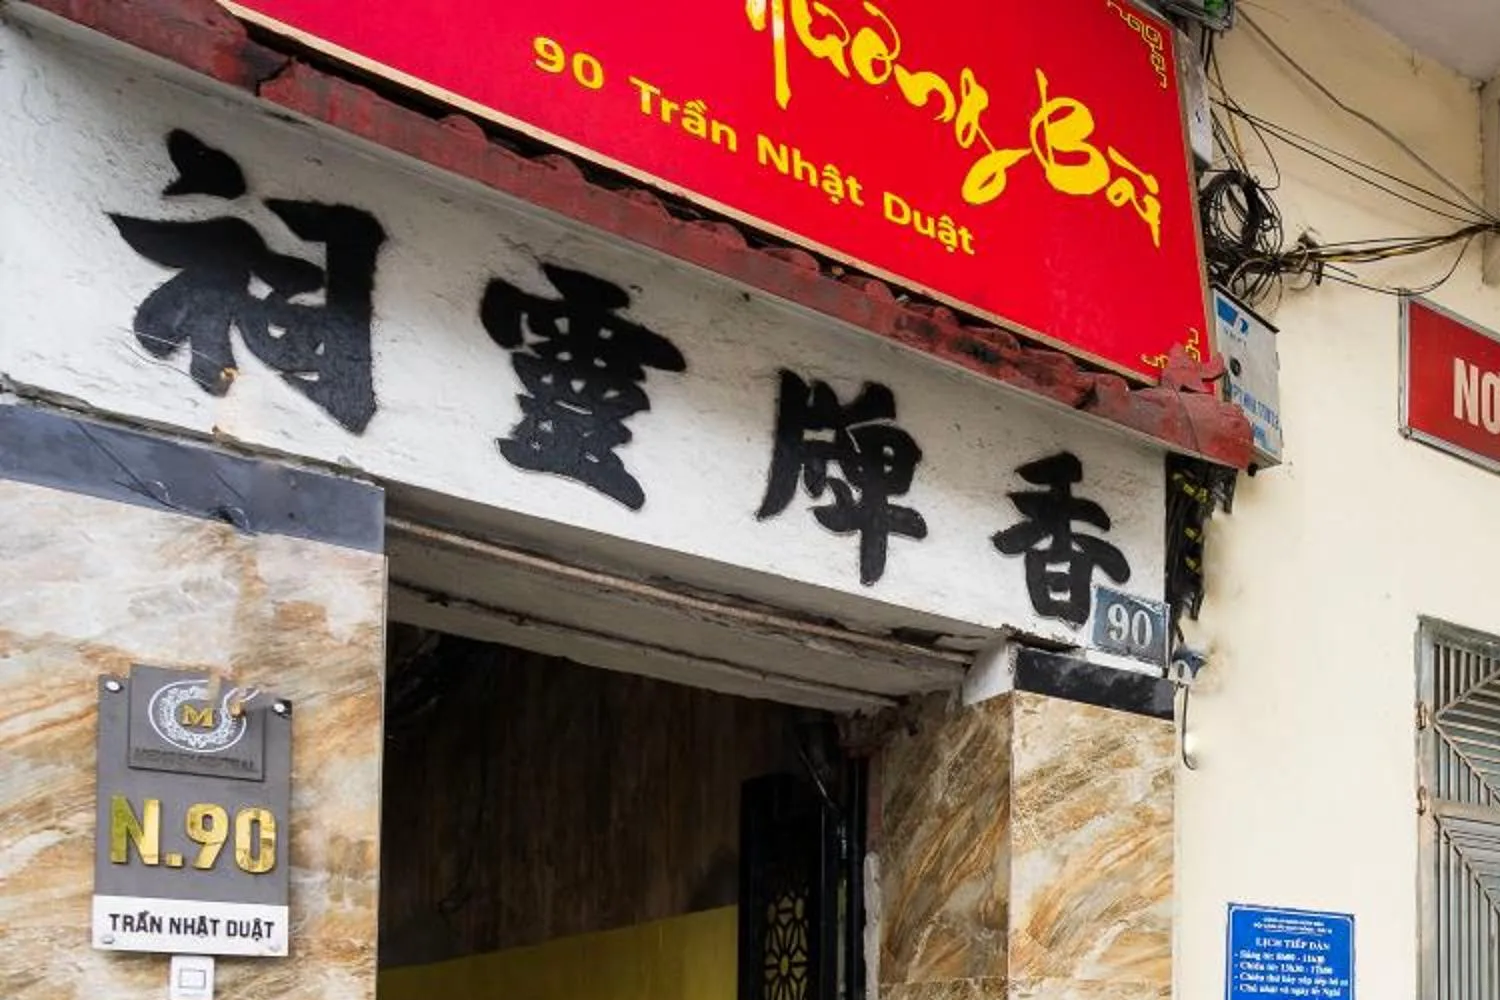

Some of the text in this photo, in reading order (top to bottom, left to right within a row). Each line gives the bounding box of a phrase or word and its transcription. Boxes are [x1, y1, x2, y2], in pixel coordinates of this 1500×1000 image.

[533, 36, 976, 256] 90 Trần Nhật Duật
[1107, 603, 1153, 649] 90
[182, 703, 214, 729] M
[109, 794, 277, 874] N.90
[226, 917, 275, 942] DUẬT
